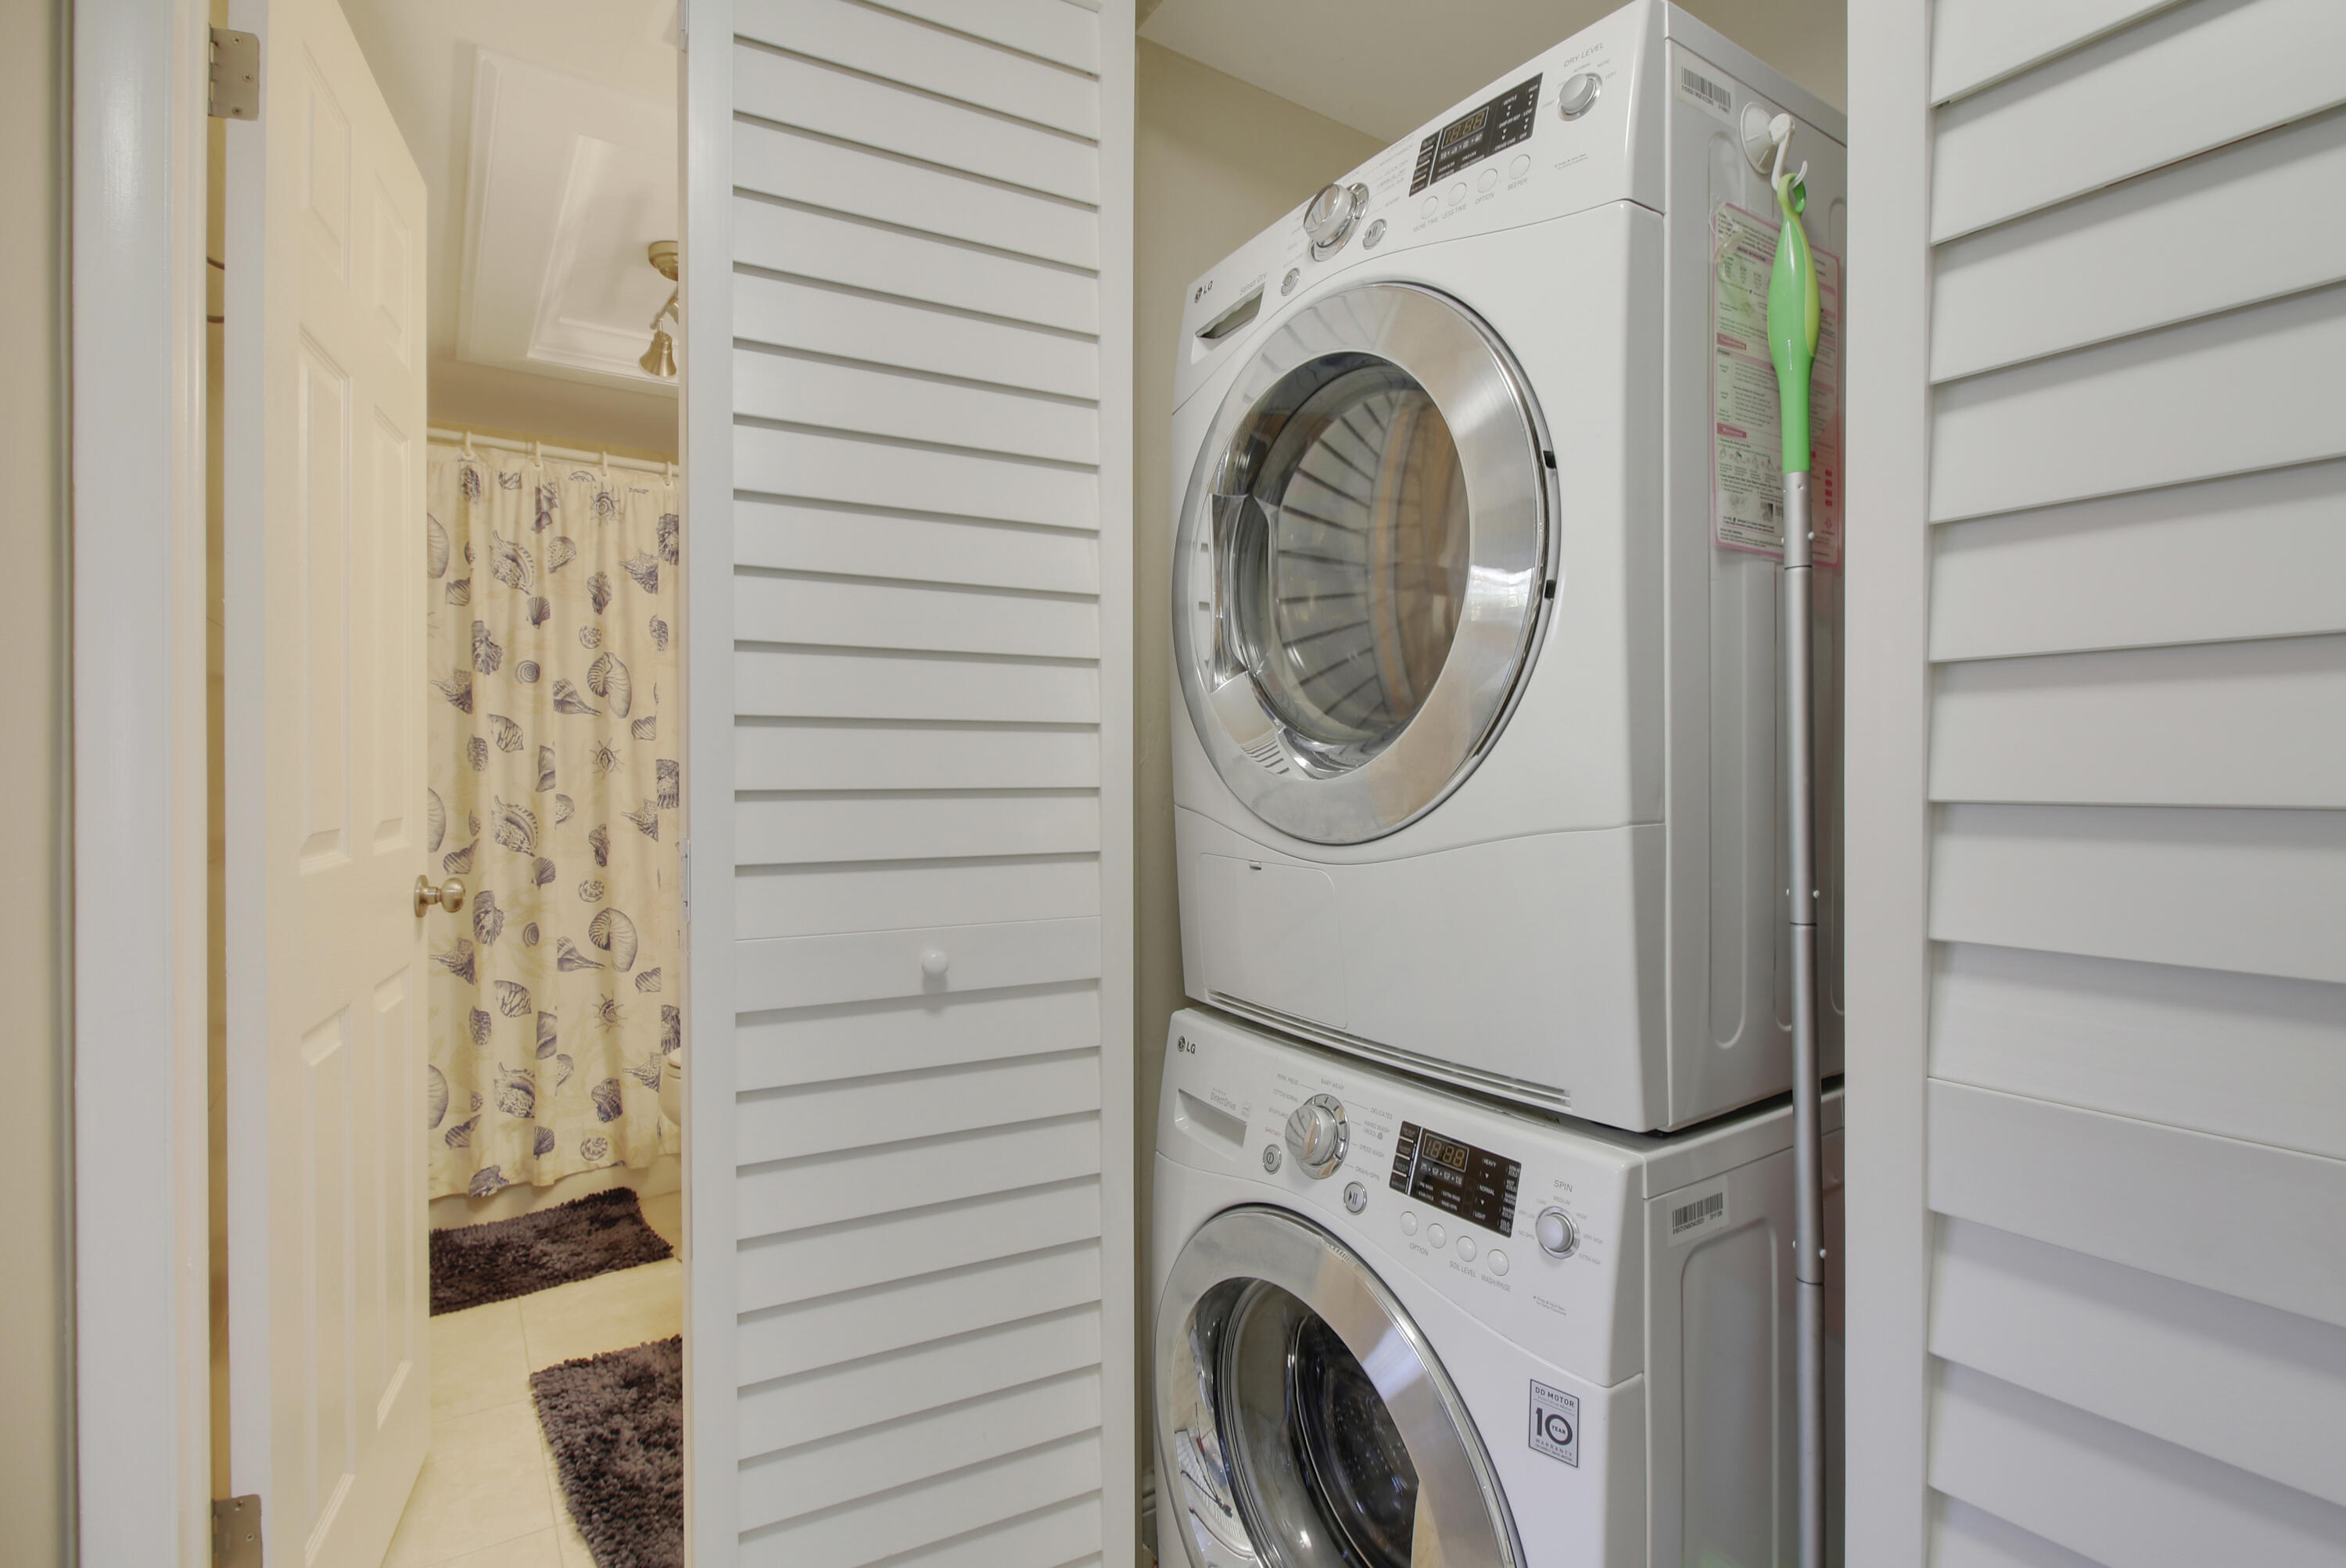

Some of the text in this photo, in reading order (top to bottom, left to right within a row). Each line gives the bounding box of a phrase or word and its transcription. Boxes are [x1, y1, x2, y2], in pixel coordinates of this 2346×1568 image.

[1564, 43, 1604, 67] DRY LEVEL
[1508, 178, 1528, 191] BEEPER
[1475, 191, 1495, 205] OPTION
[1455, 203, 1467, 213] TIME
[1203, 280, 1214, 294] LG
[1186, 1042, 1196, 1054] LG
[1479, 1184, 1495, 1197] NORMAL
[1553, 1179, 1573, 1193] SPIN
[1409, 1242, 1429, 1256] OPTION
[1449, 1261, 1476, 1278] SOIL LEVEL
[1534, 1386, 1575, 1408] DD MOTOR
[1535, 1407, 1573, 1446] 10
[1551, 1424, 1566, 1436] YEAR
[1534, 1438, 1573, 1457] WARRANTY
